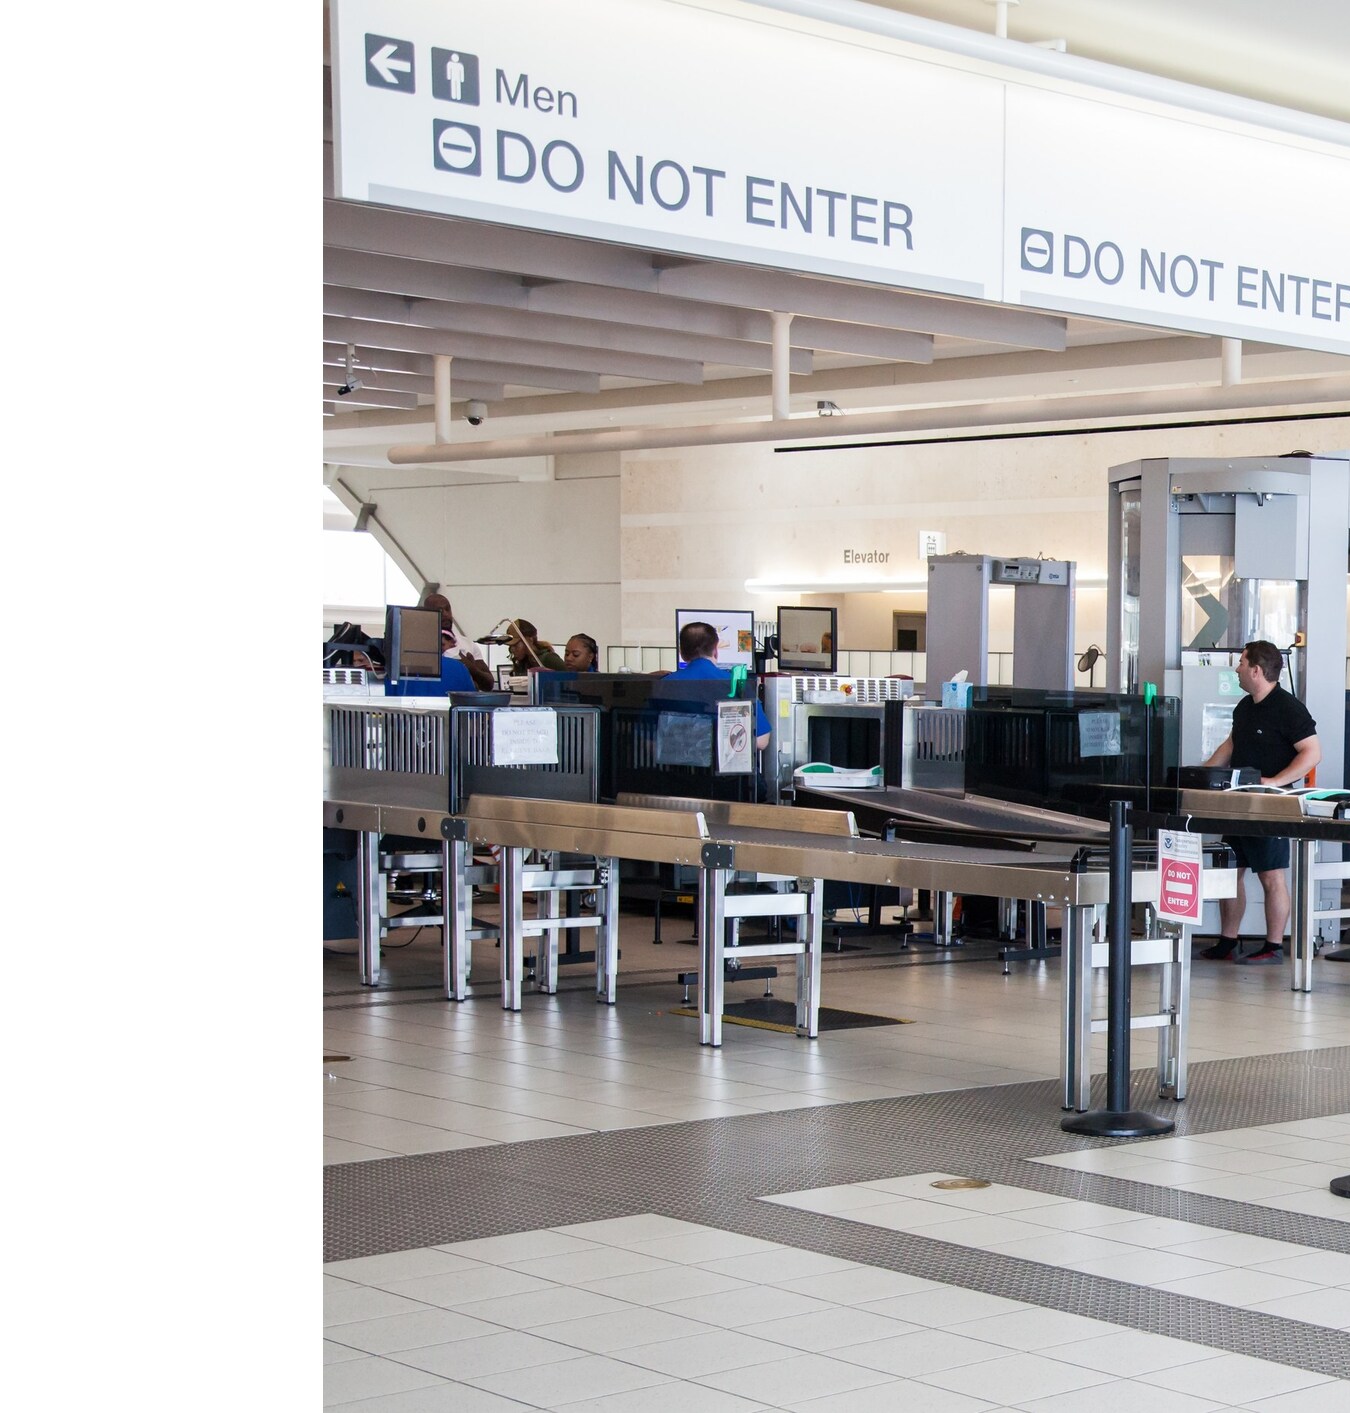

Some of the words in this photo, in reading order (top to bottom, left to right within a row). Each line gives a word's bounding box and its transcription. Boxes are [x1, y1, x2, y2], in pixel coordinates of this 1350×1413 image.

[495, 68, 578, 118] Men
[496, 128, 585, 193] DO
[607, 149, 726, 217] NOT
[745, 175, 914, 251] ENTER
[1063, 234, 1125, 286] DO
[1140, 248, 1224, 302] NOT
[843, 549, 890, 564] Elevator
[1168, 870, 1176, 878] DO
[1176, 872, 1191, 880] NOT
[1168, 896, 1189, 907] ENTER
